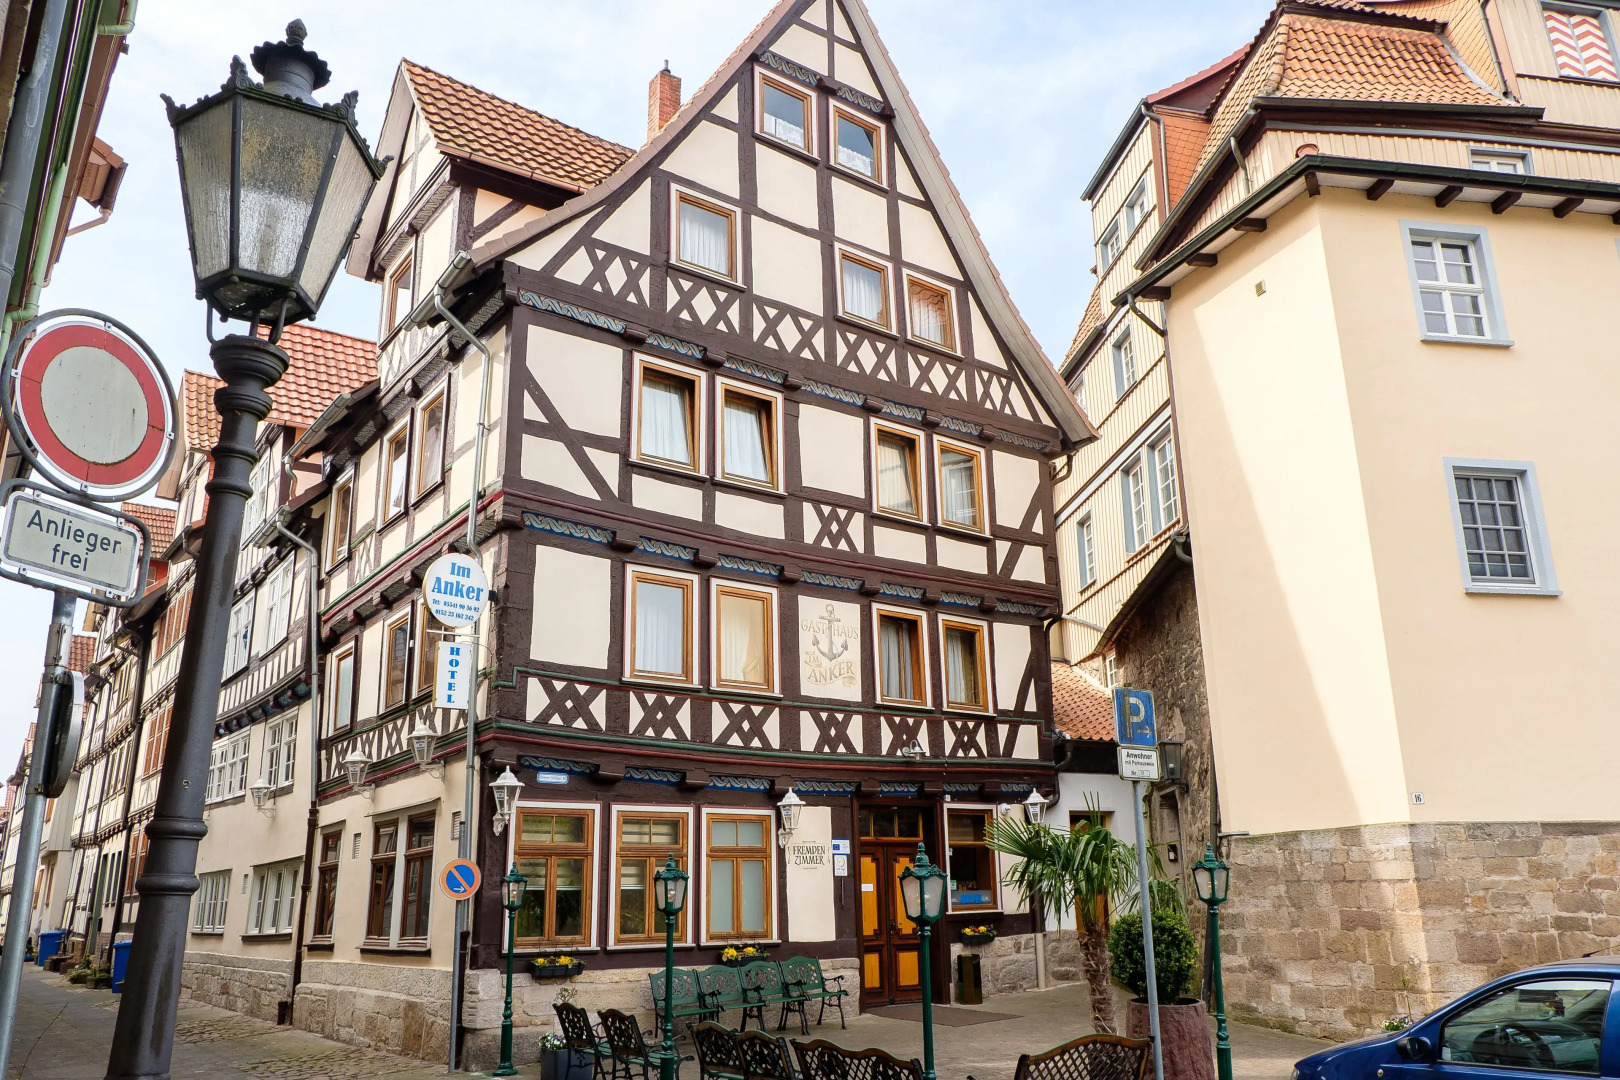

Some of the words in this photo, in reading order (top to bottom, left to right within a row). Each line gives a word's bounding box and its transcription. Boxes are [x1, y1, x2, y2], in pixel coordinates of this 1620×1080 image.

[27, 509, 122, 553] Anlieger
[52, 543, 89, 572] frei
[450, 561, 471, 579] Im
[431, 576, 484, 602] Anker
[435, 608, 447, 616] 0152
[443, 600, 458, 609] 05541
[800, 618, 827, 635] GAST
[832, 623, 859, 640] HAUS
[446, 646, 461, 704] HOTEL
[807, 660, 855, 683] ANKER
[1124, 696, 1146, 738] P
[1126, 751, 1153, 760] Anwohner
[1414, 793, 1422, 803] 16
[792, 845, 826, 856] FREMDEN
[794, 855, 825, 866] ZIMMER
